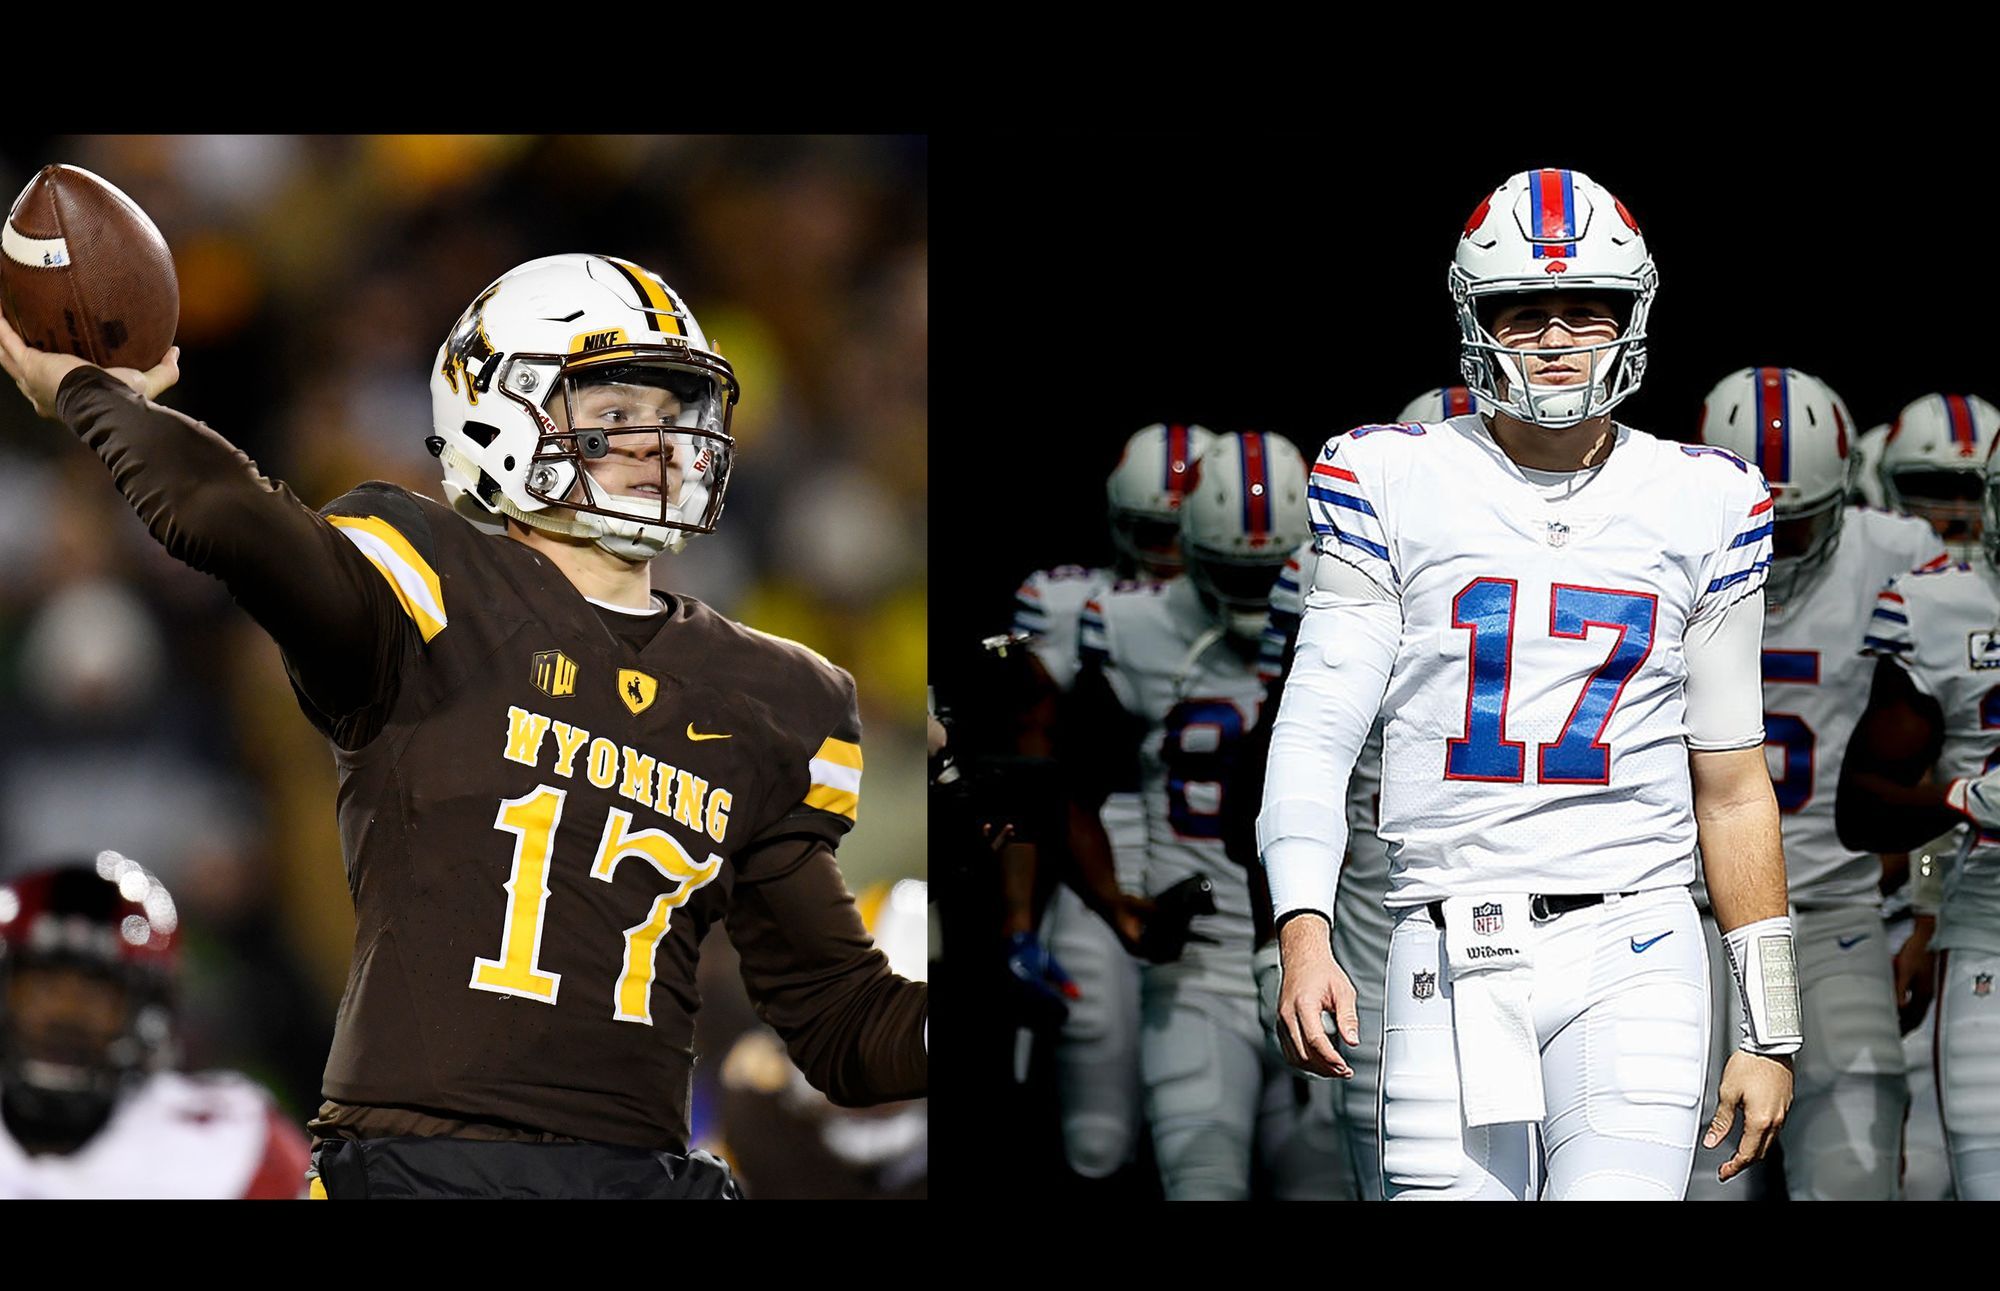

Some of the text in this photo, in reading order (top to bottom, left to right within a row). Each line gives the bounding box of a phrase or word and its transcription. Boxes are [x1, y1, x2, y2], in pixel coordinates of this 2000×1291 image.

[582, 331, 619, 352] NIKE
[1444, 576, 1659, 786] 17
[503, 705, 734, 844] WYOMING
[469, 783, 724, 1026] 17
[1476, 917, 1501, 933] NFL
[1465, 946, 1514, 960] Wilson
